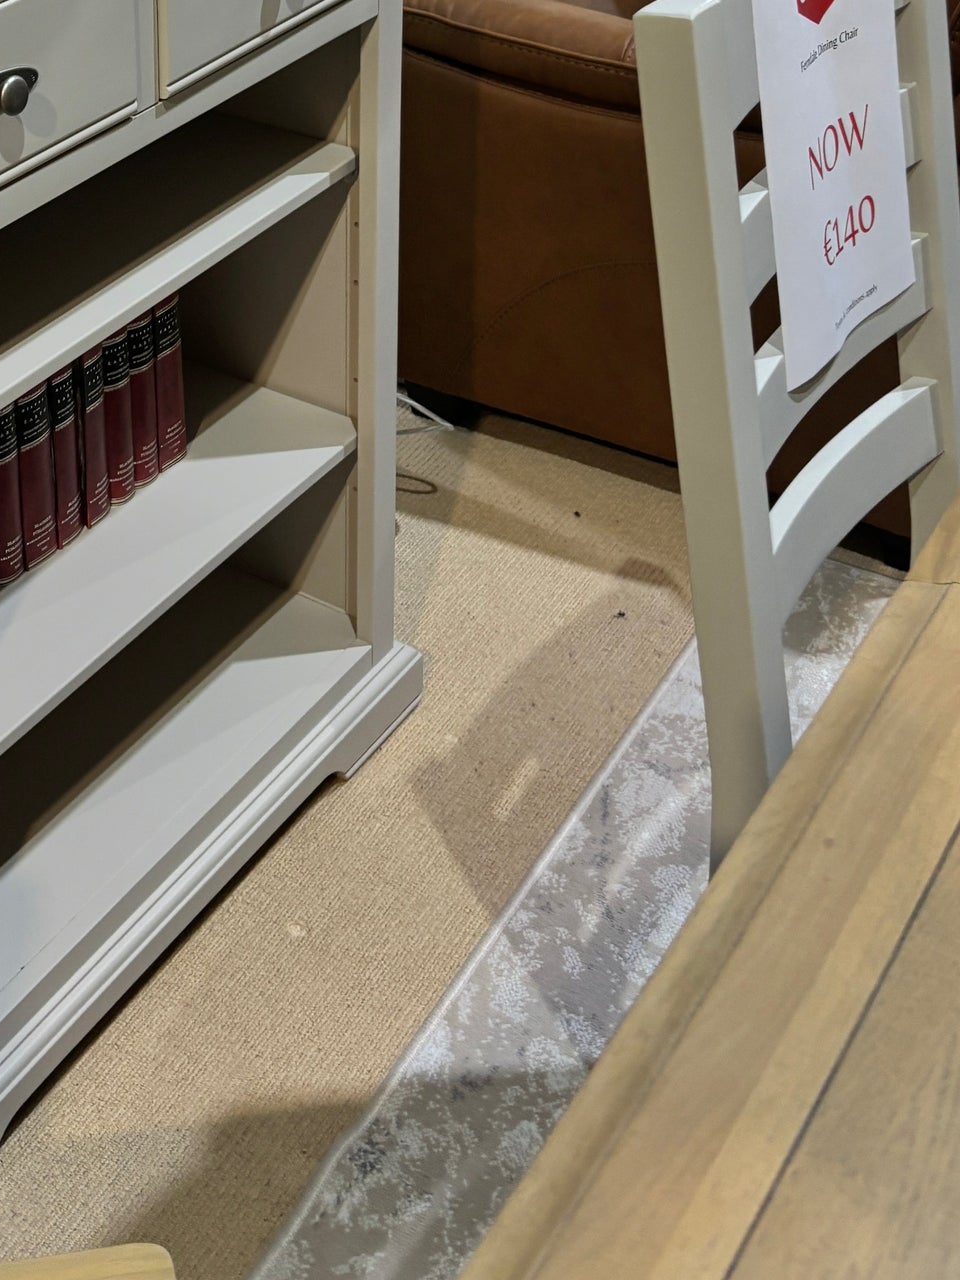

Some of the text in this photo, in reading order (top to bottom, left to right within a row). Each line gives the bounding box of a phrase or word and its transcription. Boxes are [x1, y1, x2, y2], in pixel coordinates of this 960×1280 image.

[817, 39, 838, 56] Dining
[839, 26, 859, 44] Chair
[808, 104, 869, 191] NOW
[823, 195, 876, 266] €140
